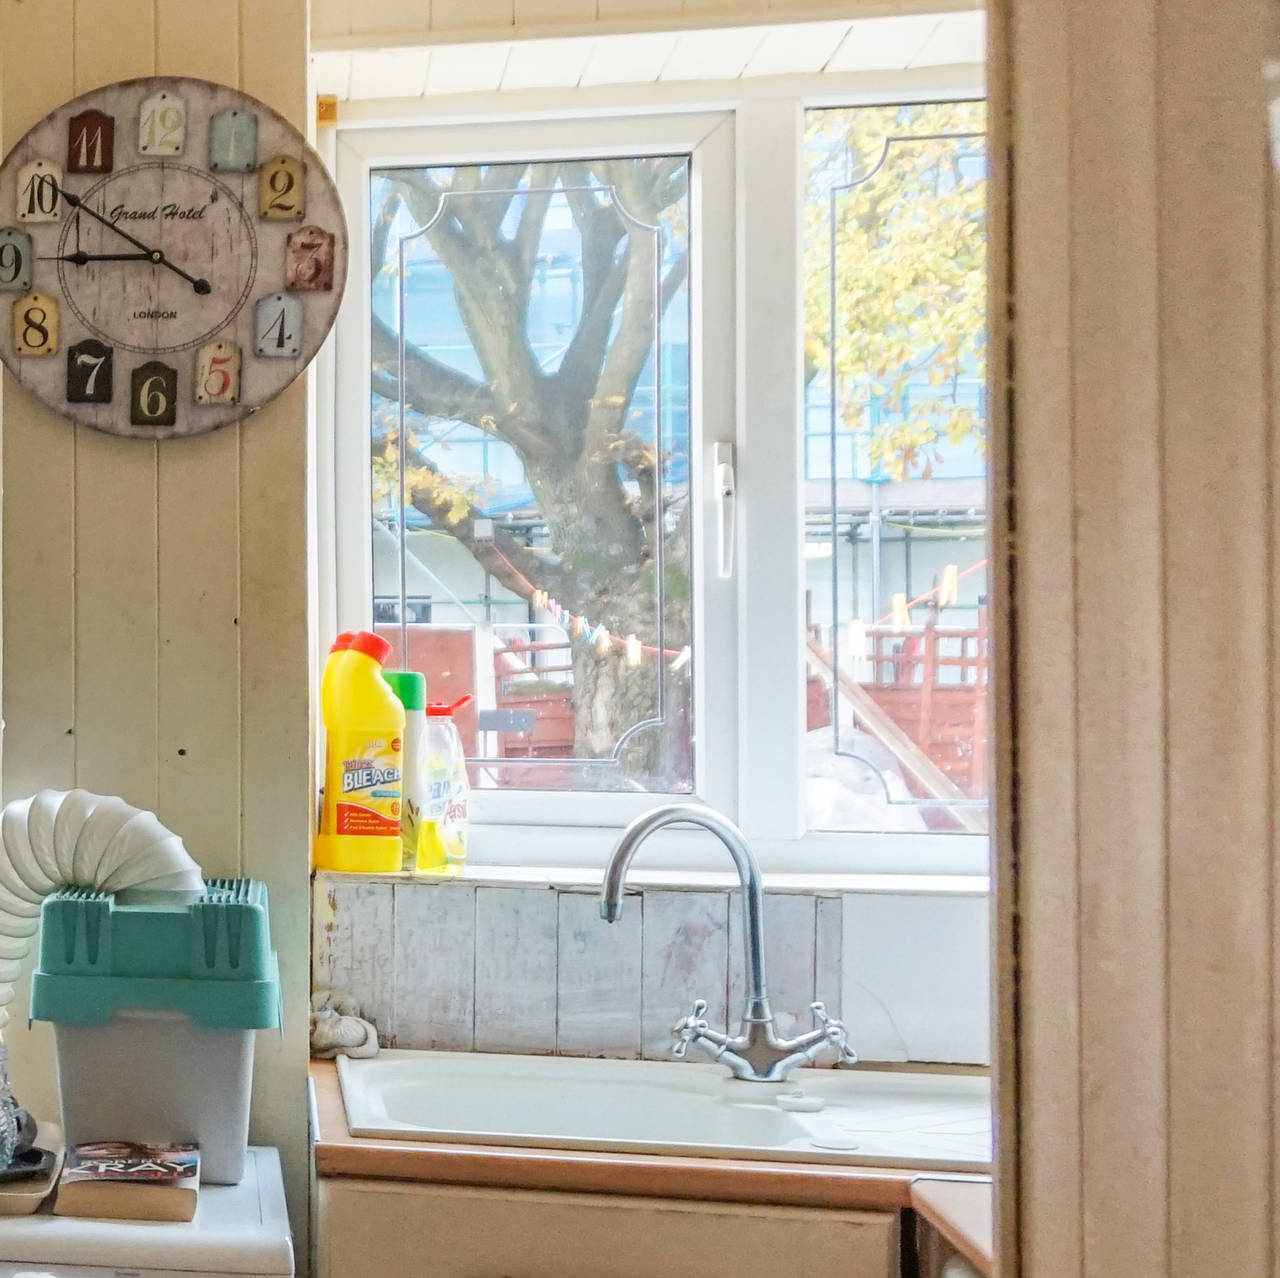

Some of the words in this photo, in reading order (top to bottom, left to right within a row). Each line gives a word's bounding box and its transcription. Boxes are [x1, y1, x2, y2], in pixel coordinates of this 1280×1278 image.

[75, 127, 103, 167] 11
[145, 108, 183, 149] 12
[22, 173, 58, 215] 10
[269, 169, 296, 212] 2
[110, 204, 159, 226] Grand
[161, 203, 207, 220] Hotel
[296, 241, 323, 281] 3
[23, 307, 48, 349] 8
[133, 311, 177, 319] LONDON
[262, 307, 292, 349] 4
[76, 354, 105, 394] 7
[203, 356, 233, 397] 5
[139, 376, 167, 416] 6
[343, 768, 401, 792] BLEACH
